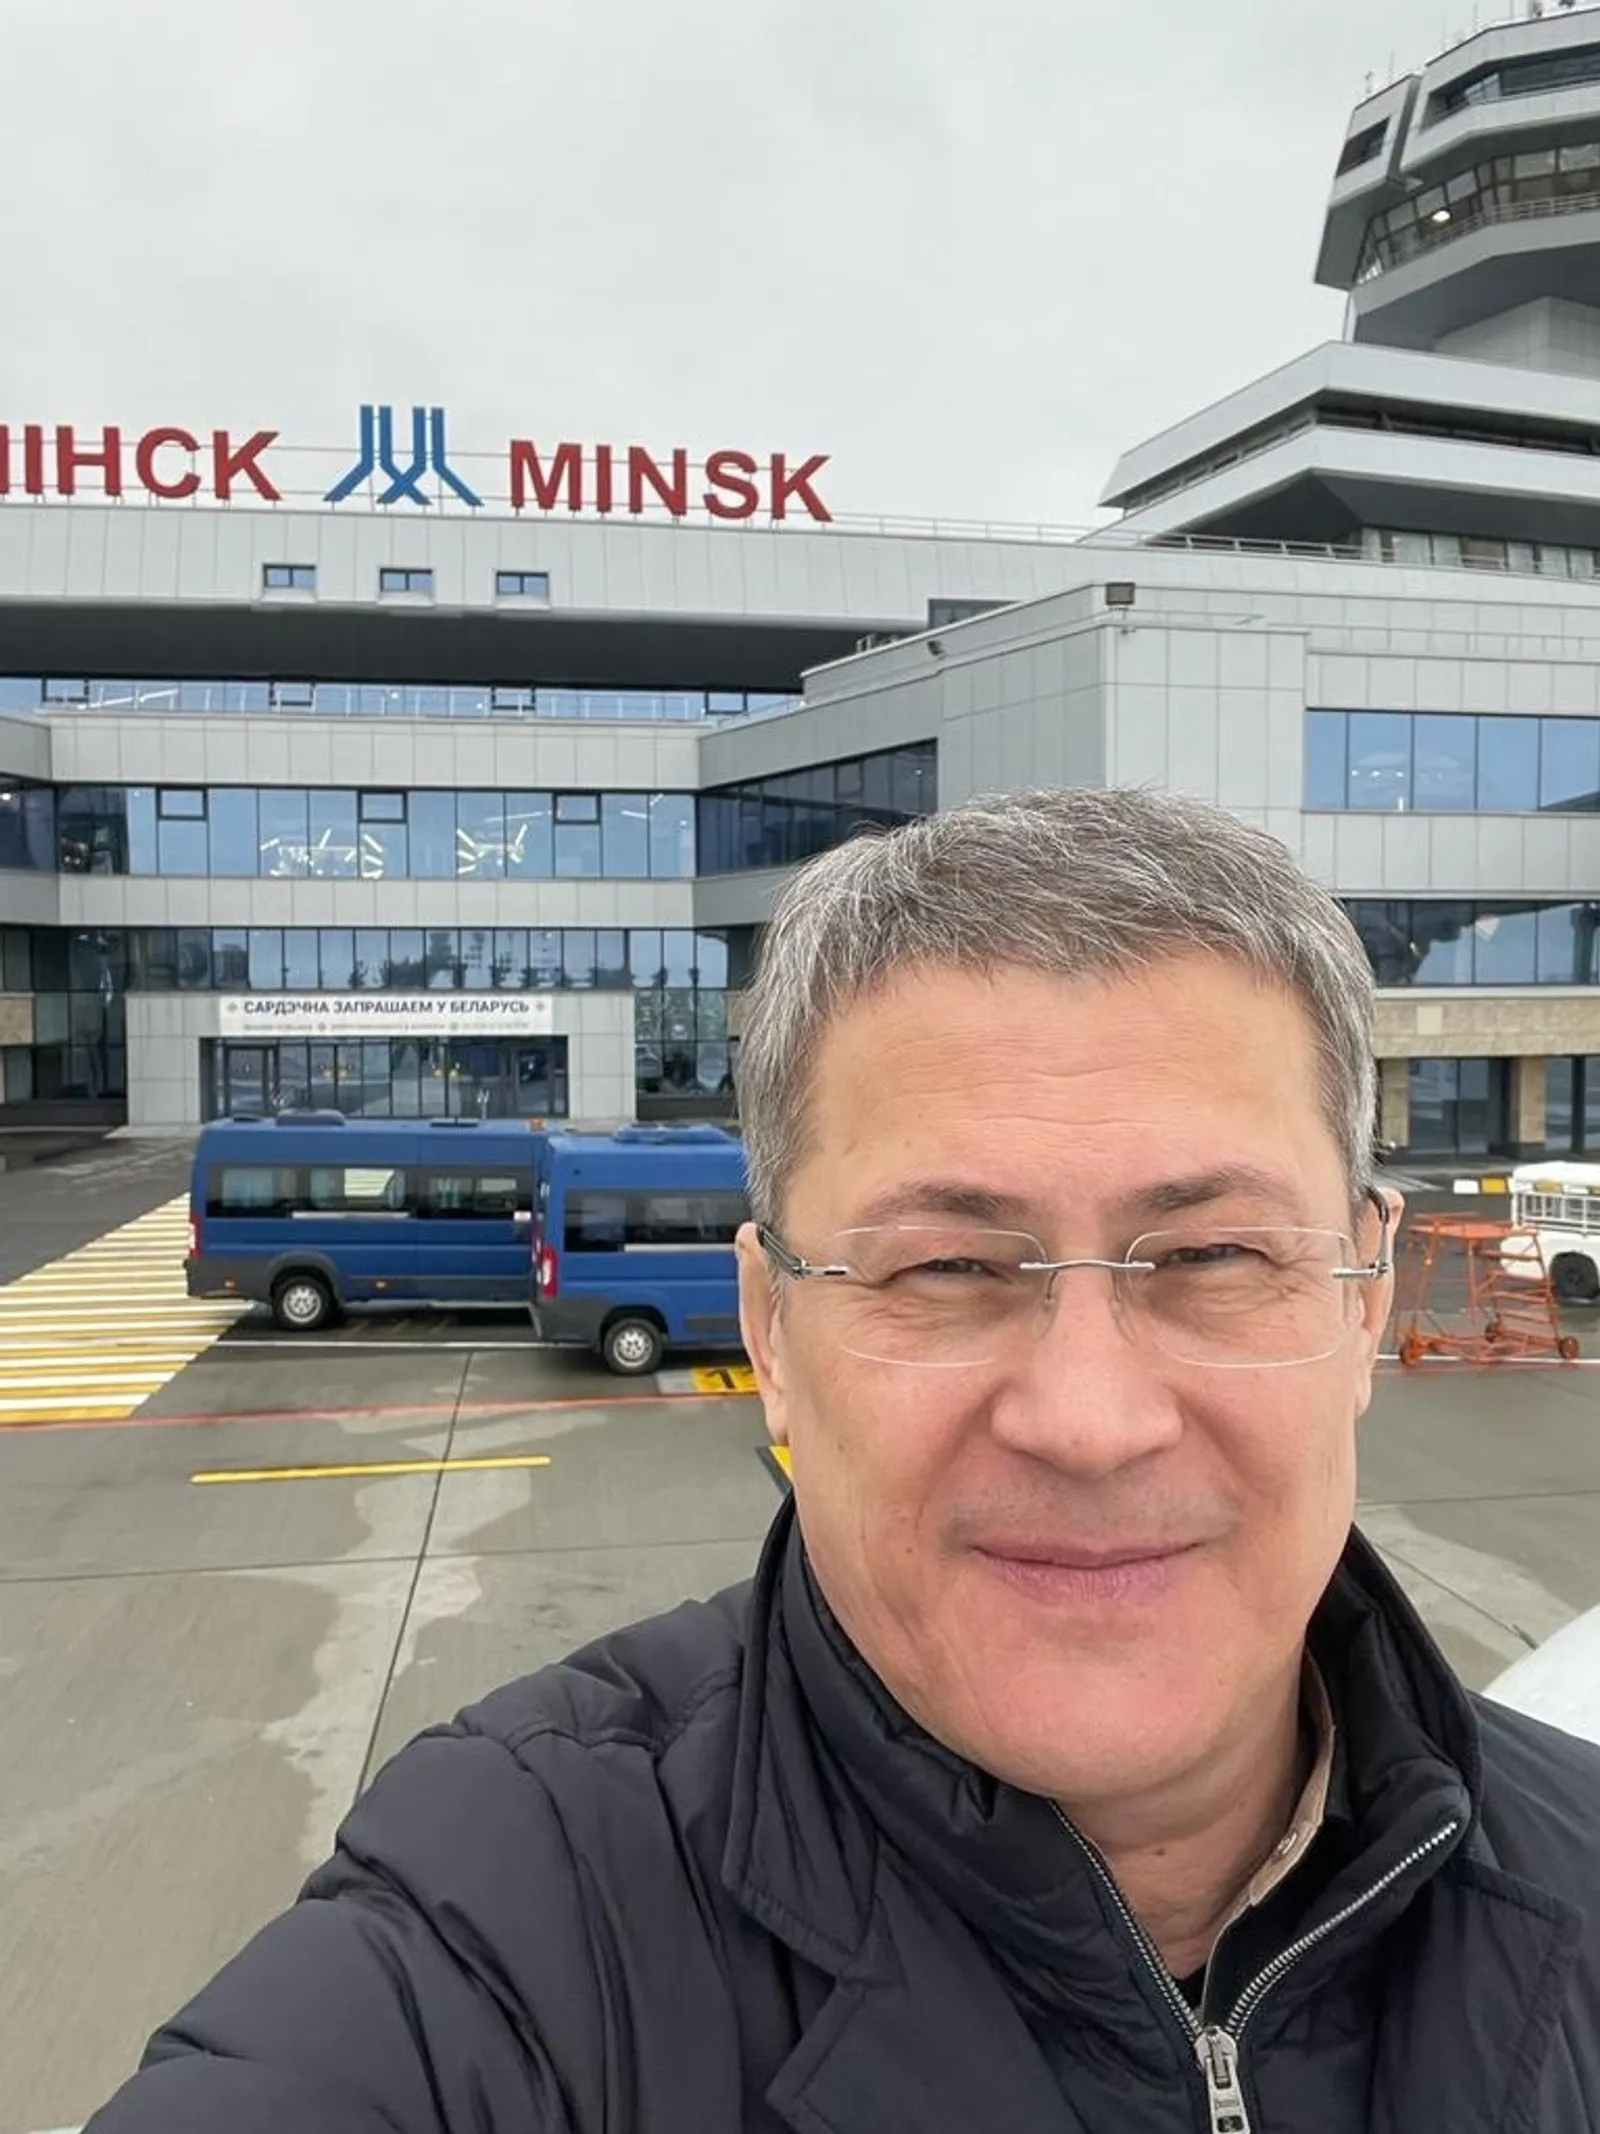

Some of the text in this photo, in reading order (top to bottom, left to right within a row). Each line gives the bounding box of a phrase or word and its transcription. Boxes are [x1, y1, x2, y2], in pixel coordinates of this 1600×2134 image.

[0, 424, 281, 500] ІНСК
[510, 439, 832, 522] MINSK
[243, 1000, 530, 1016] САРДЭЧНА ЗАПРАШАЕМ У БЕЛАРУСЬ
